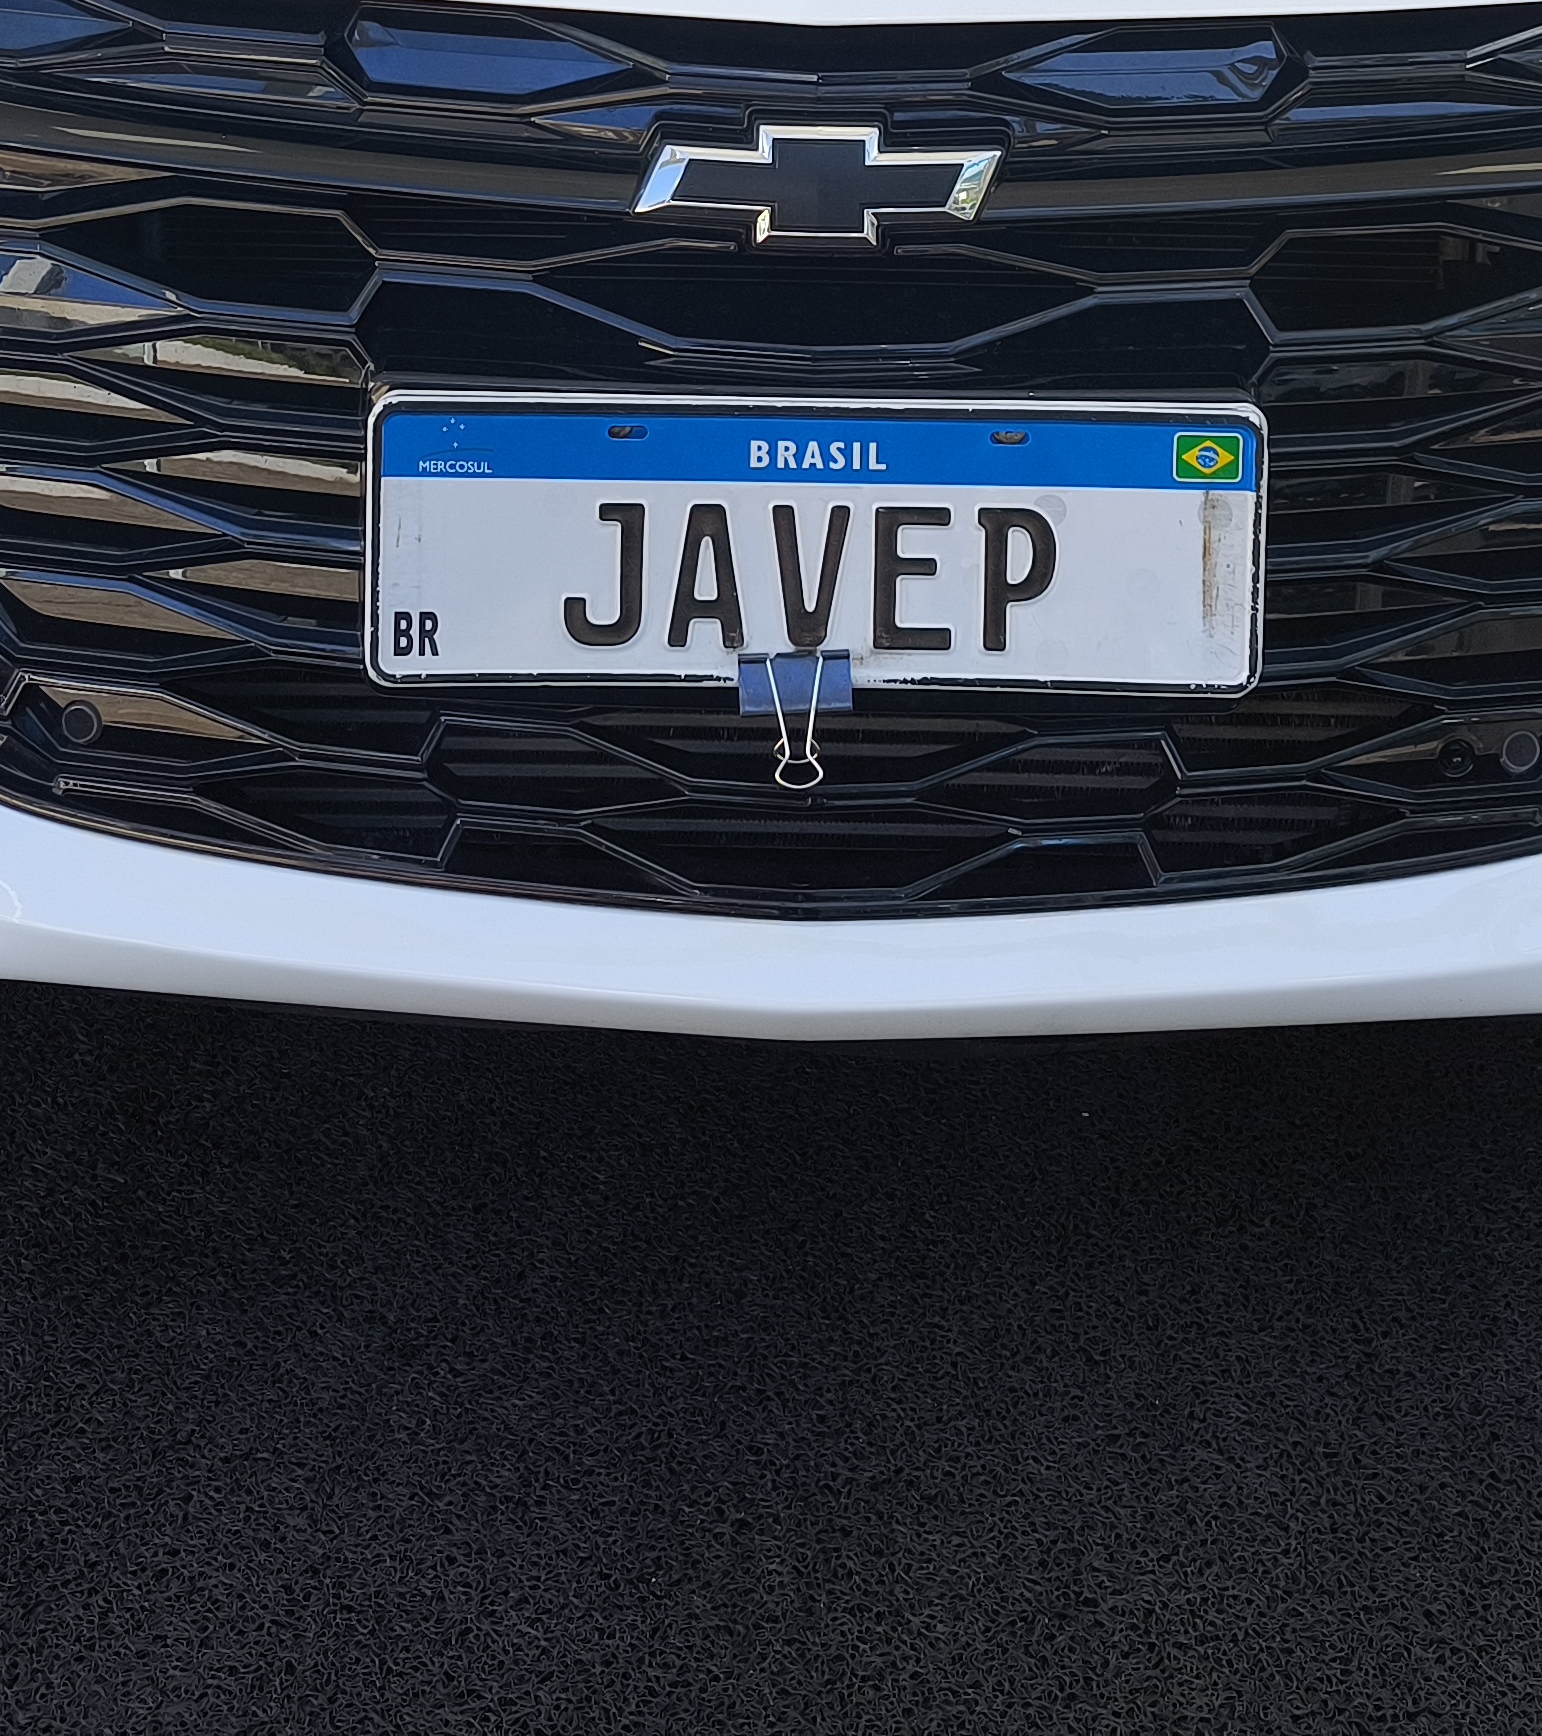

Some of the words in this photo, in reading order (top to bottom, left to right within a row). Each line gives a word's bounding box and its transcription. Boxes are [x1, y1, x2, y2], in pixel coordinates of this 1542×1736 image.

[418, 460, 493, 474] MERCOSUL
[749, 439, 887, 471] BRASIL
[562, 501, 1058, 653] JAVEP
[392, 610, 441, 658] BR
